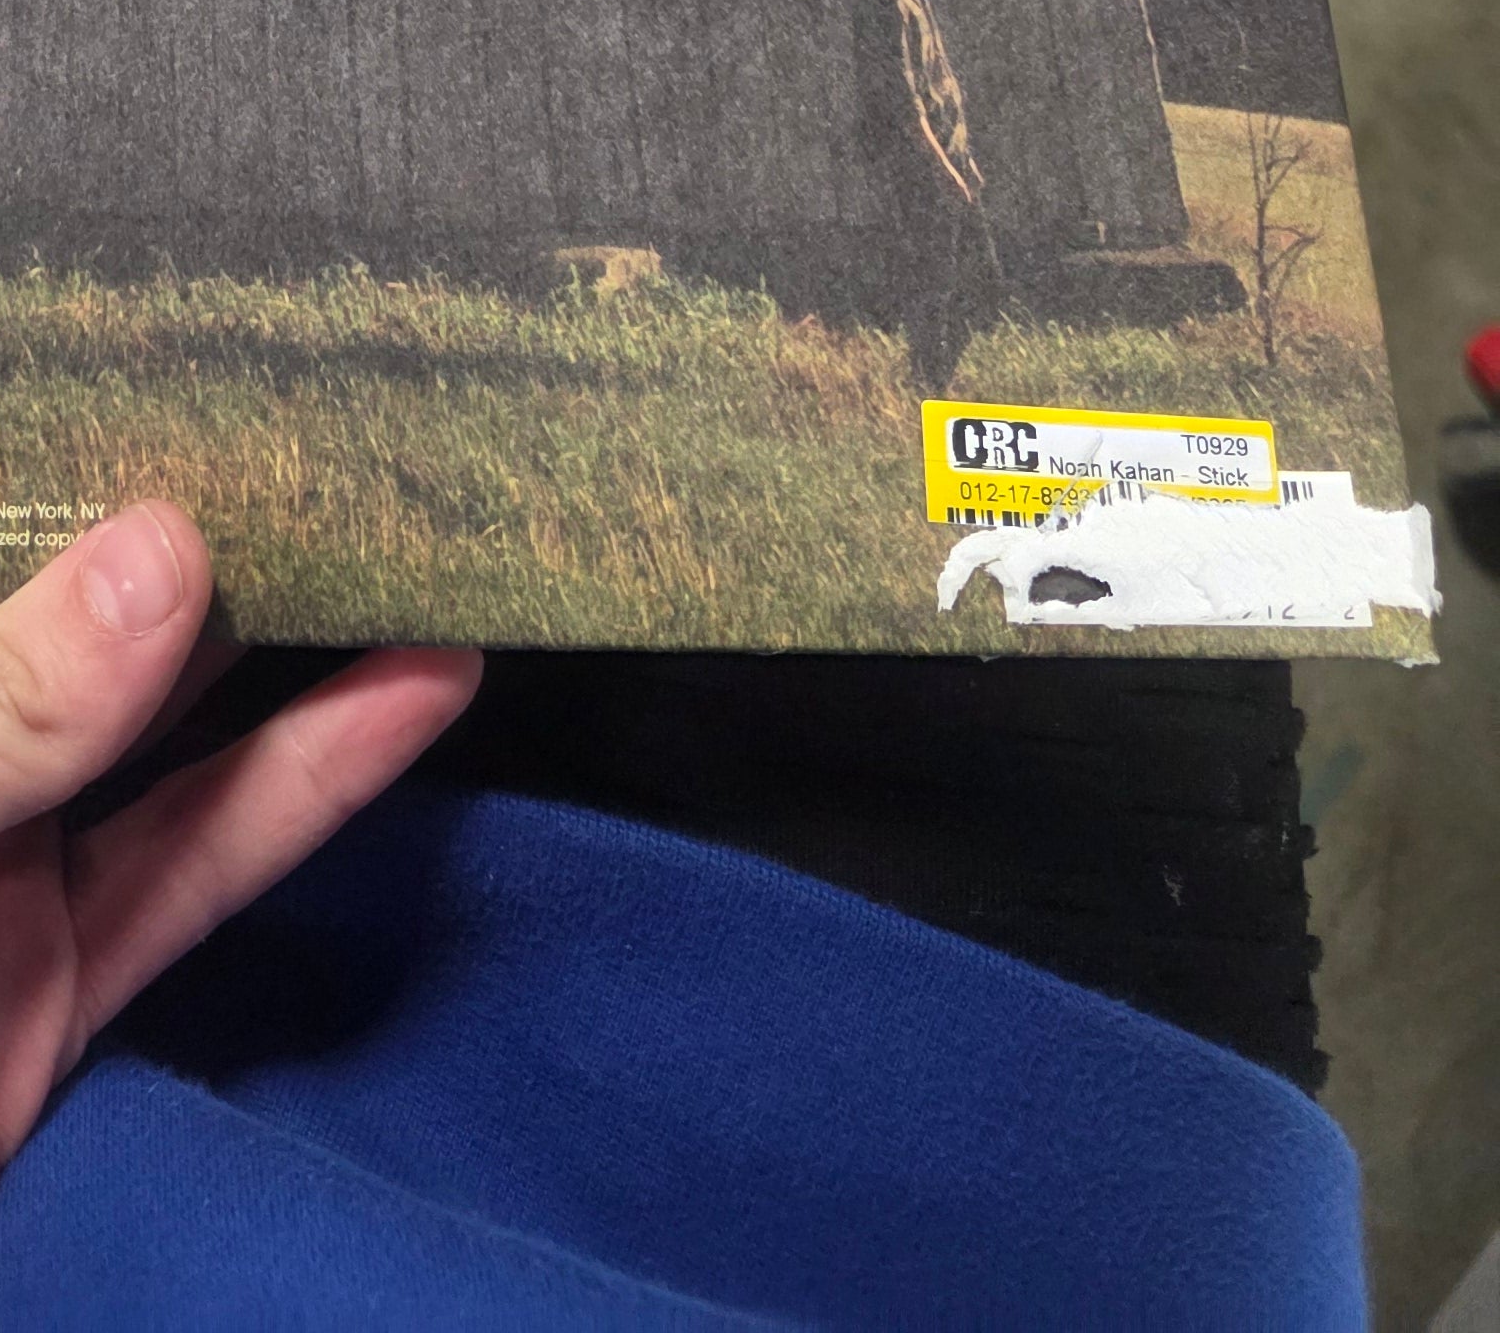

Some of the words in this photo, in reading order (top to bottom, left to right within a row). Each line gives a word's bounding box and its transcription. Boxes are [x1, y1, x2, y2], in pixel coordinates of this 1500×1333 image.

[952, 418, 1039, 472] CRC
[1180, 434, 1248, 456] T0929
[1110, 460, 1175, 482] Kahan
[1198, 466, 1250, 487] Stick
[36, 502, 77, 520] York,
[81, 502, 106, 519] NY
[34, 530, 85, 550] copy
